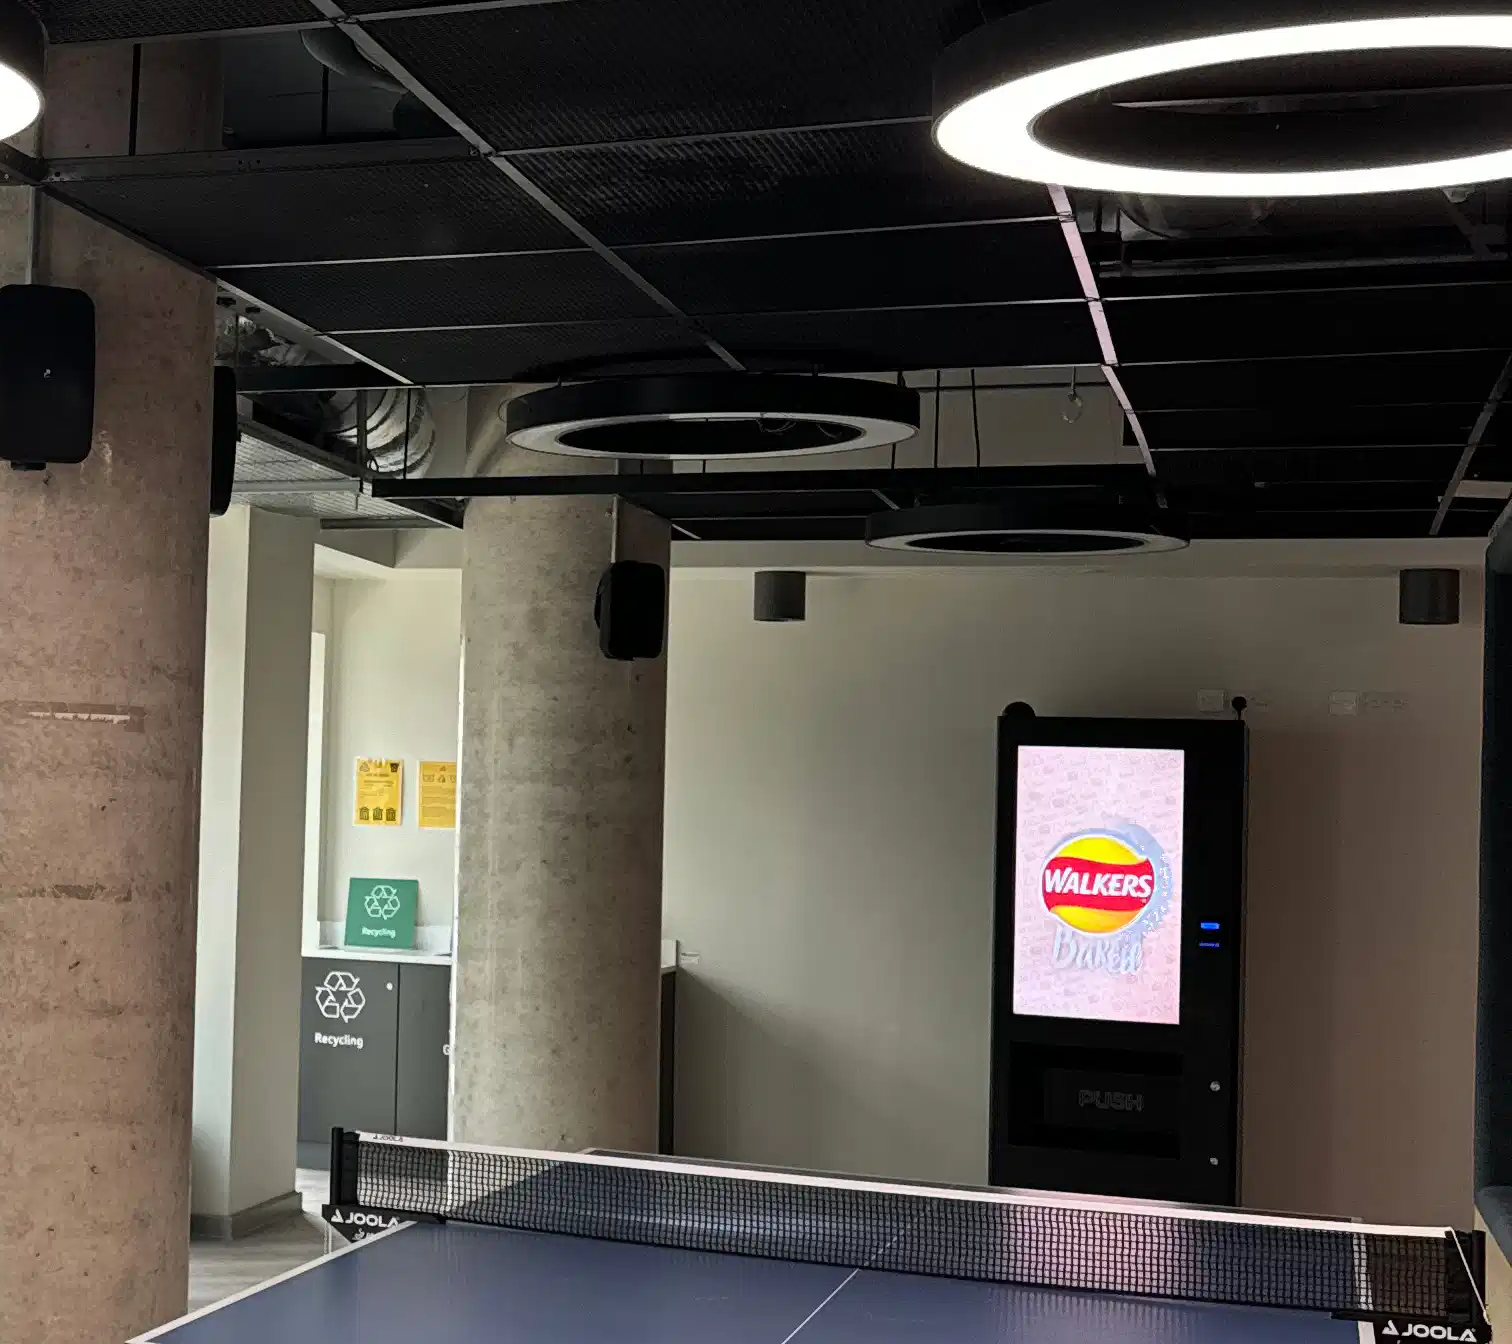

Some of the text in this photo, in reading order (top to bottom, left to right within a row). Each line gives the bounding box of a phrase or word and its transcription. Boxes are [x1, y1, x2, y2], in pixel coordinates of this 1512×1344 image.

[1044, 867, 1153, 898] WALKERS
[361, 926, 396, 939] Recycling
[314, 1032, 364, 1050] Recycling
[1078, 1089, 1144, 1112] PUSH
[345, 1212, 399, 1228] JOOLA
[1401, 1323, 1477, 1342] JOOLA
